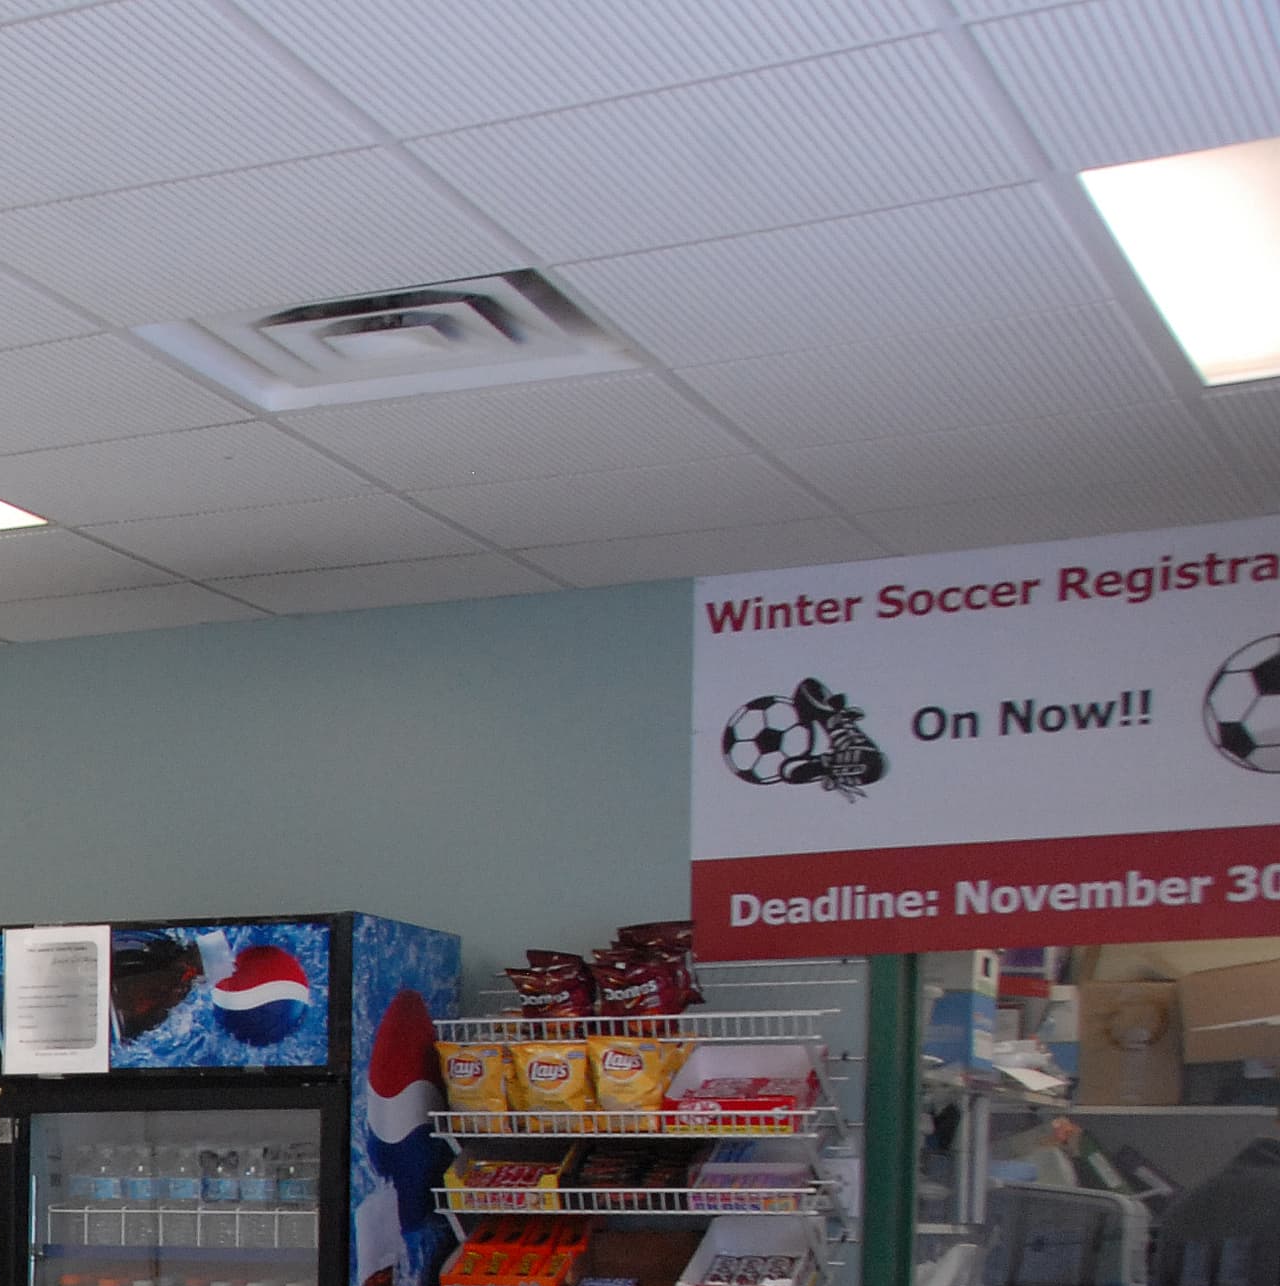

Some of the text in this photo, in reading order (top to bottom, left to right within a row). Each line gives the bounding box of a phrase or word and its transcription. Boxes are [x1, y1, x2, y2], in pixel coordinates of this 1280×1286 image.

[706, 552, 1280, 633] Winter Soccer Registra
[912, 690, 1153, 742] On Now!!
[730, 864, 1280, 927] Deadline: November 30
[604, 980, 657, 1000] Doritos
